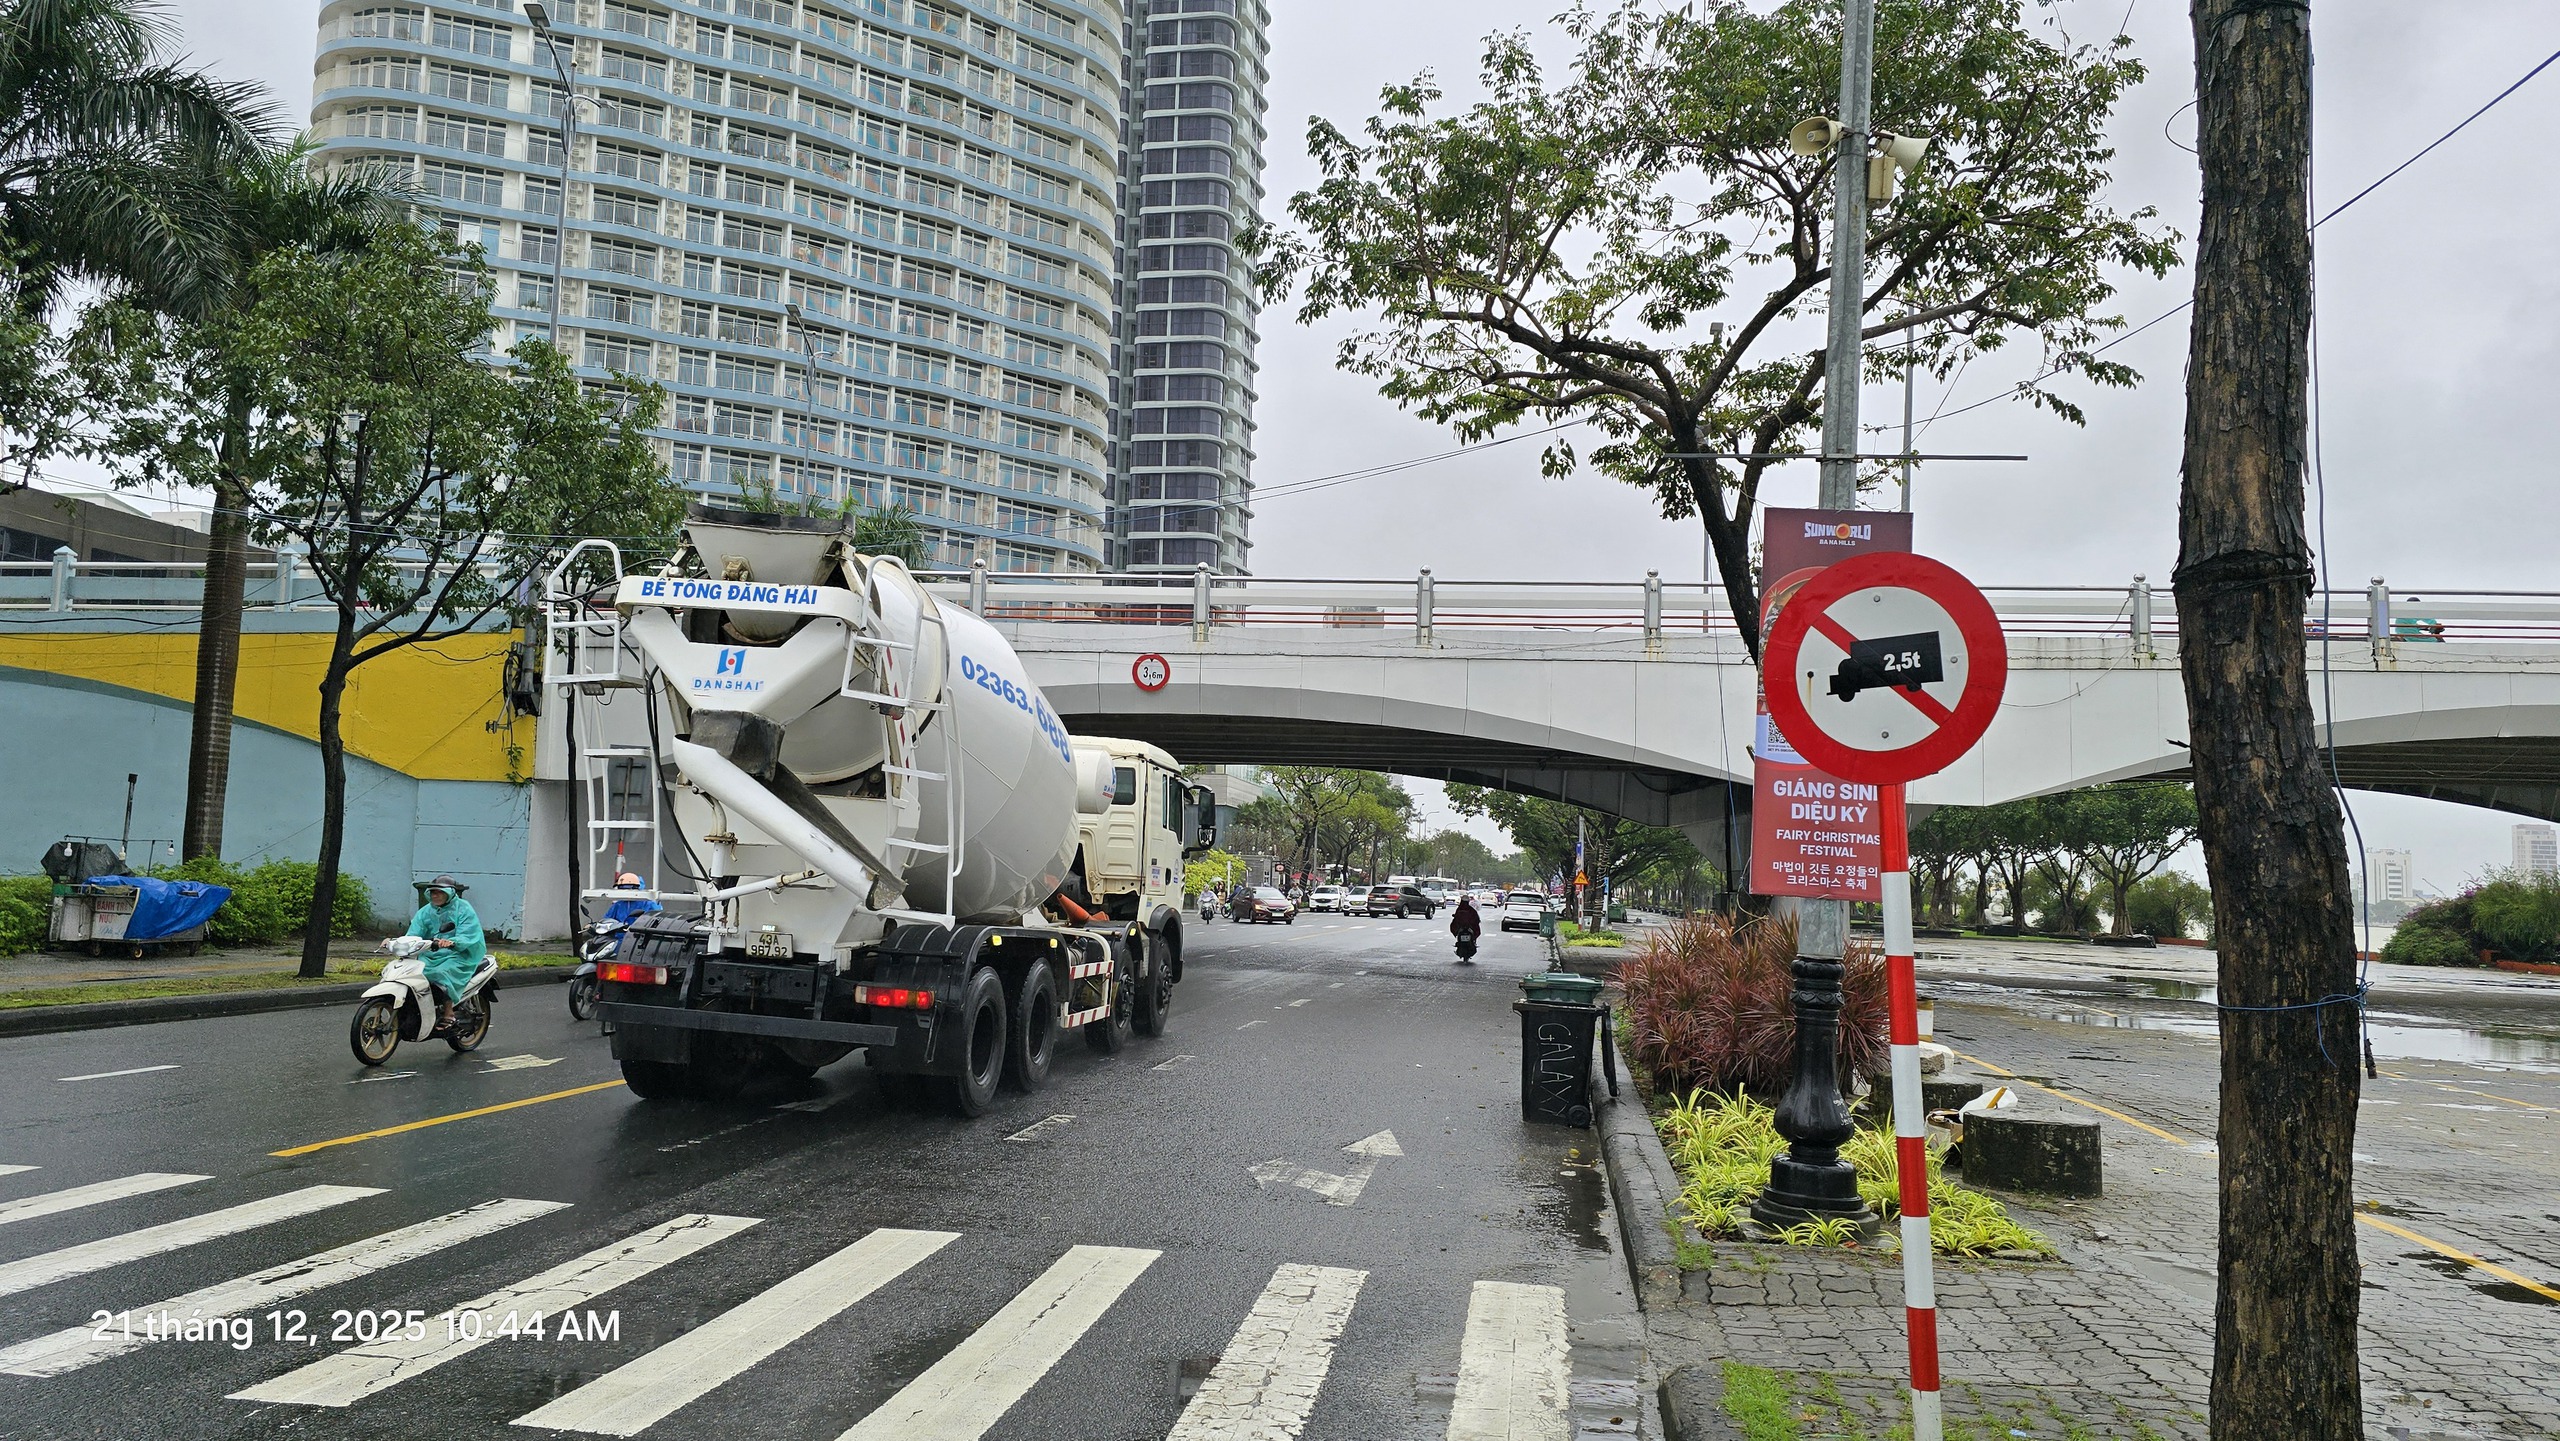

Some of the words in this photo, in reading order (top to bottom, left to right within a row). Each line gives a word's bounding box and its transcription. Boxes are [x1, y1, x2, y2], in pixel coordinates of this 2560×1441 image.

[672, 579, 722, 600] TÔNG
[727, 583, 779, 604] ĐĂNG
[1883, 651, 1921, 672] 2,5t
[1143, 666, 1163, 680] 3,6m
[1773, 778, 1835, 799] GIÁNG
[1791, 801, 1837, 825] DIỆU
[1840, 803, 1868, 823] KỲ
[1776, 829, 1812, 840] FAIRY
[1813, 831, 1880, 845] CHRISTMAS
[1800, 844, 1857, 858] FESTIVAL
[1772, 861, 1804, 873] 마법이
[1809, 863, 1831, 875] 깃든
[1834, 865, 1878, 878] 요정들의
[1786, 875, 1841, 888] 크리스마스
[1845, 878, 1867, 890] 축제
[759, 933, 779, 945] 43A
[1538, 1022, 1575, 1117] GALAXY
